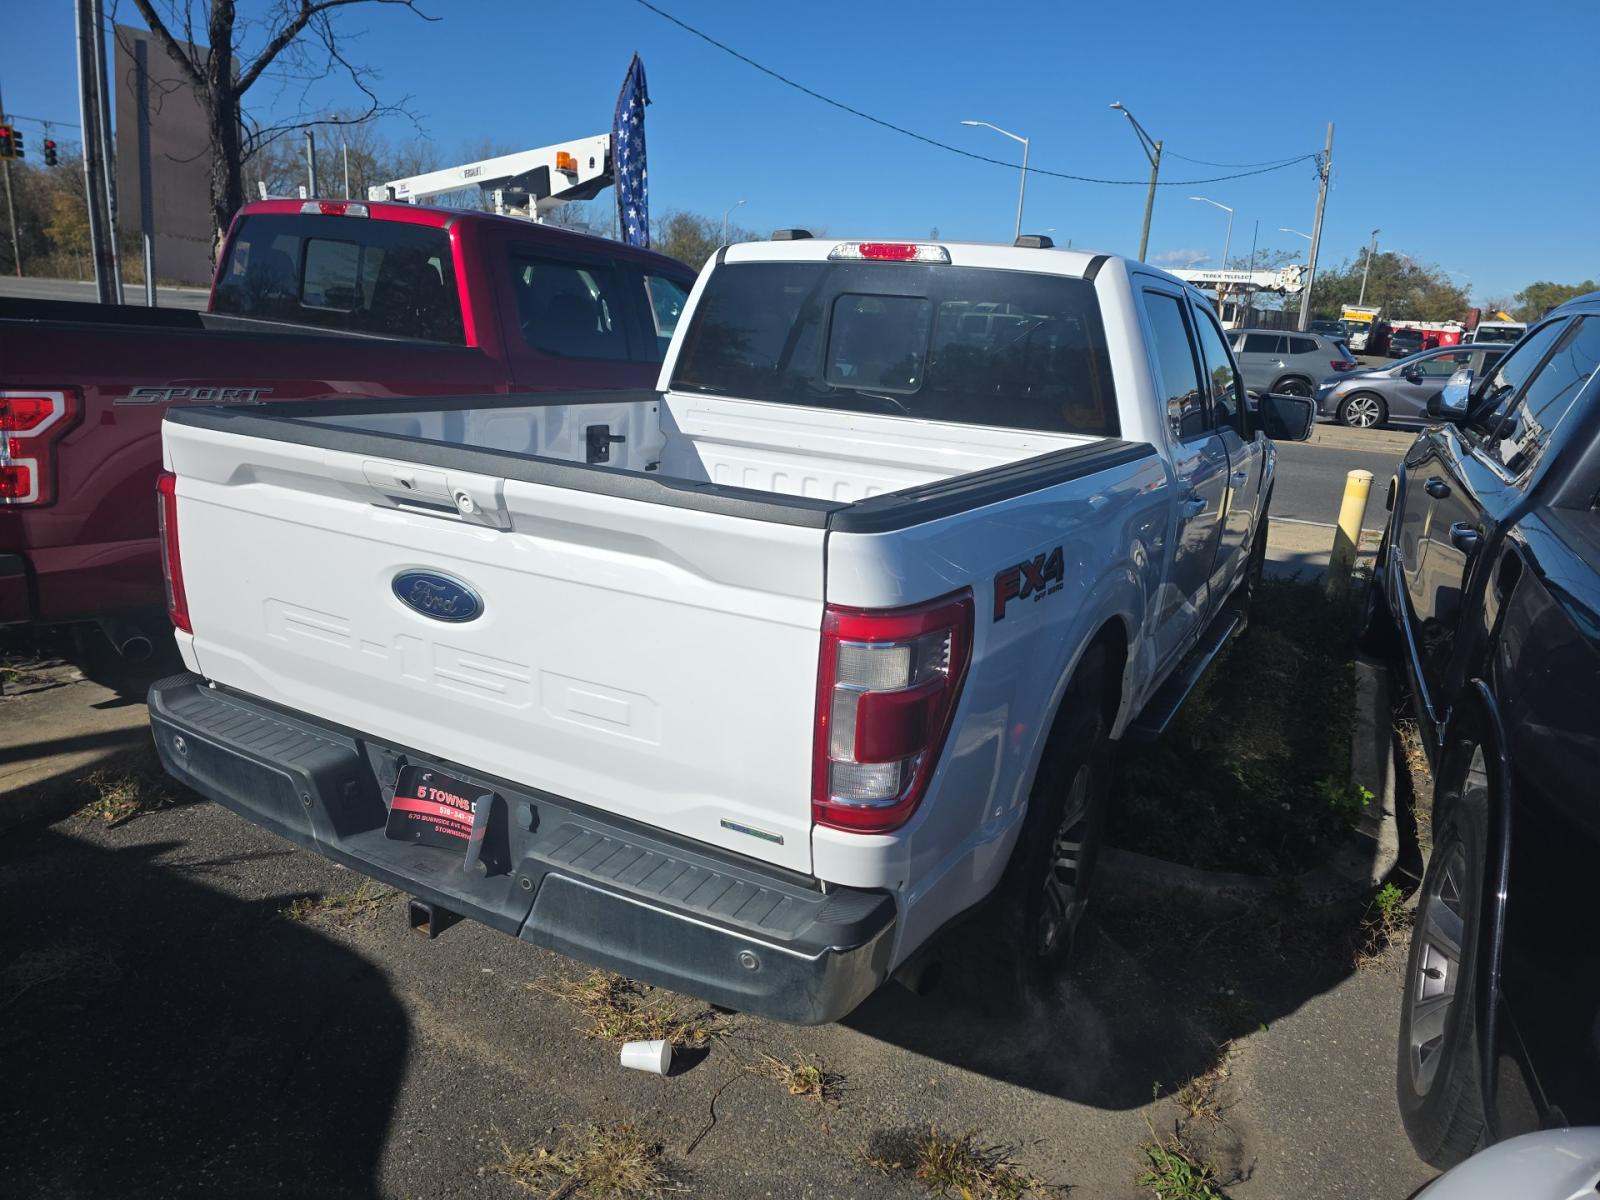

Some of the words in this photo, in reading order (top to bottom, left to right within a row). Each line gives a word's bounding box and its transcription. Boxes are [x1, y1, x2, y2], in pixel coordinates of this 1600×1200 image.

[113, 387, 274, 406] SPORT
[410, 579, 460, 613] Ford
[993, 545, 1065, 623] FX4
[261, 596, 662, 748] F-150
[417, 785, 427, 799] 5
[429, 787, 470, 811] TOWNS
